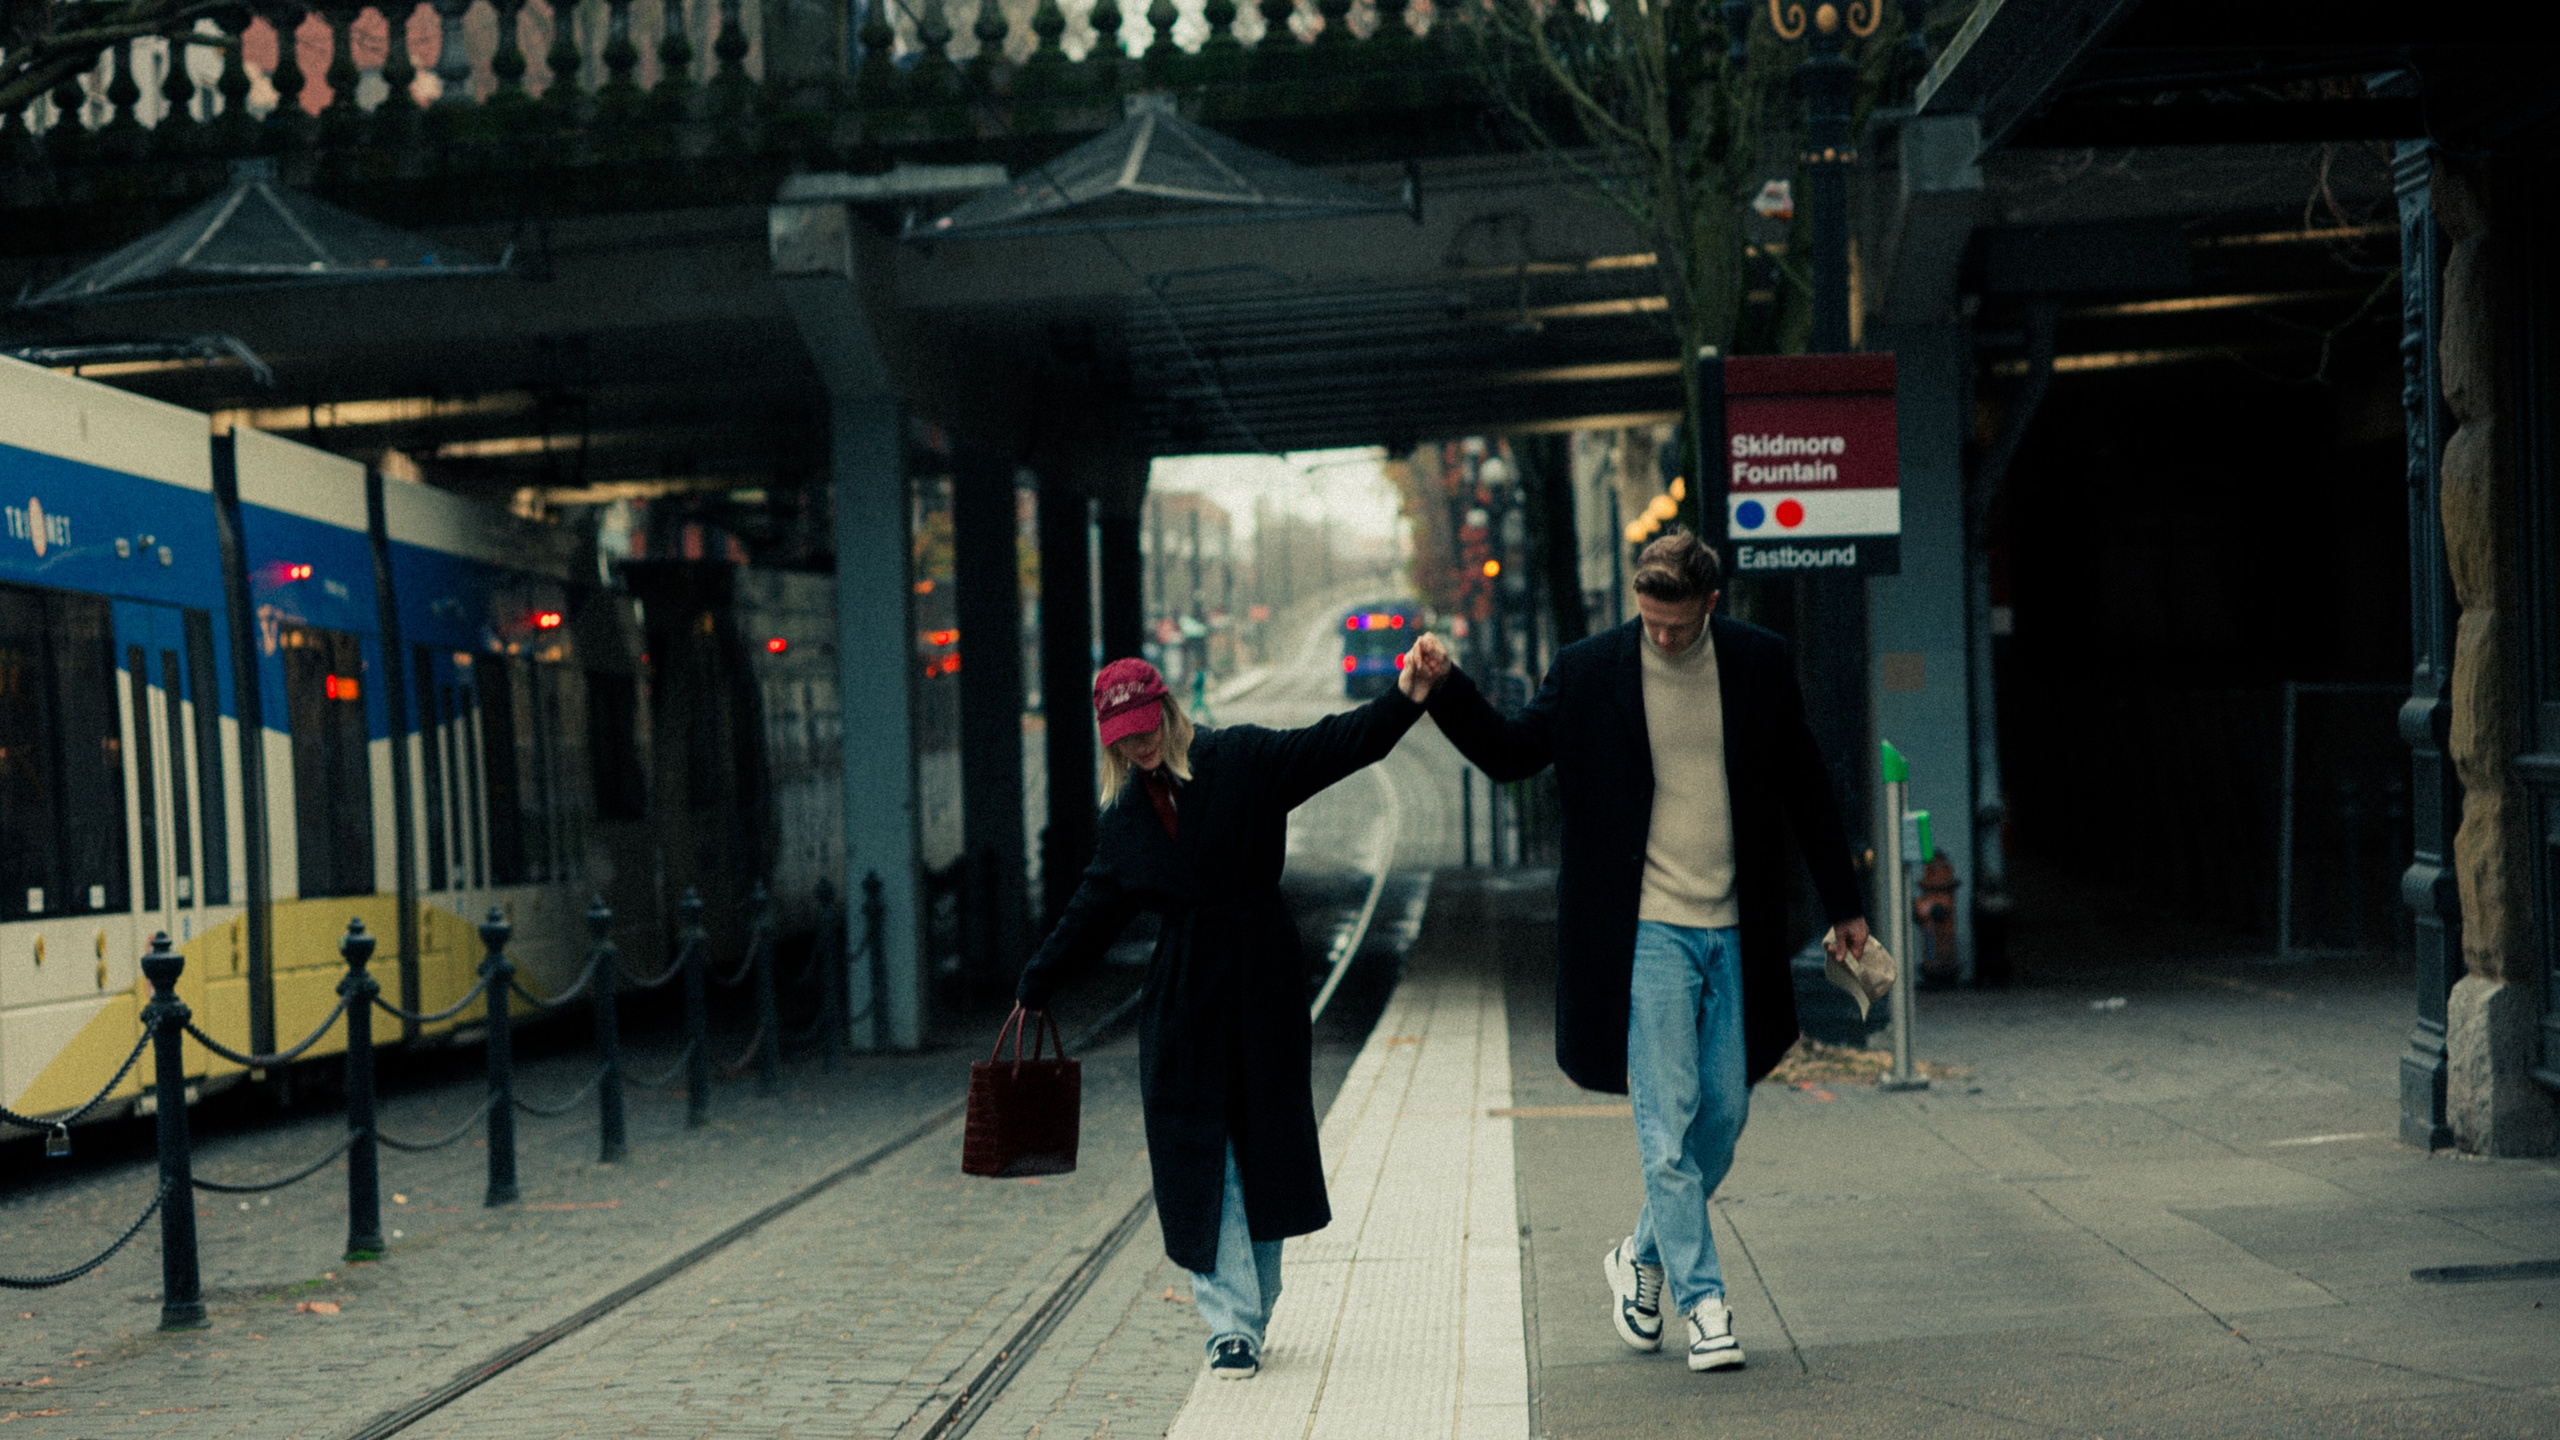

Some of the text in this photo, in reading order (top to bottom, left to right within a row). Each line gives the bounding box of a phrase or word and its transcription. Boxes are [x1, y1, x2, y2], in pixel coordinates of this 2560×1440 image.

[1732, 434, 1846, 457] Skidmore
[1733, 460, 1838, 484] Fountain
[1738, 544, 1856, 568] Eastbound
